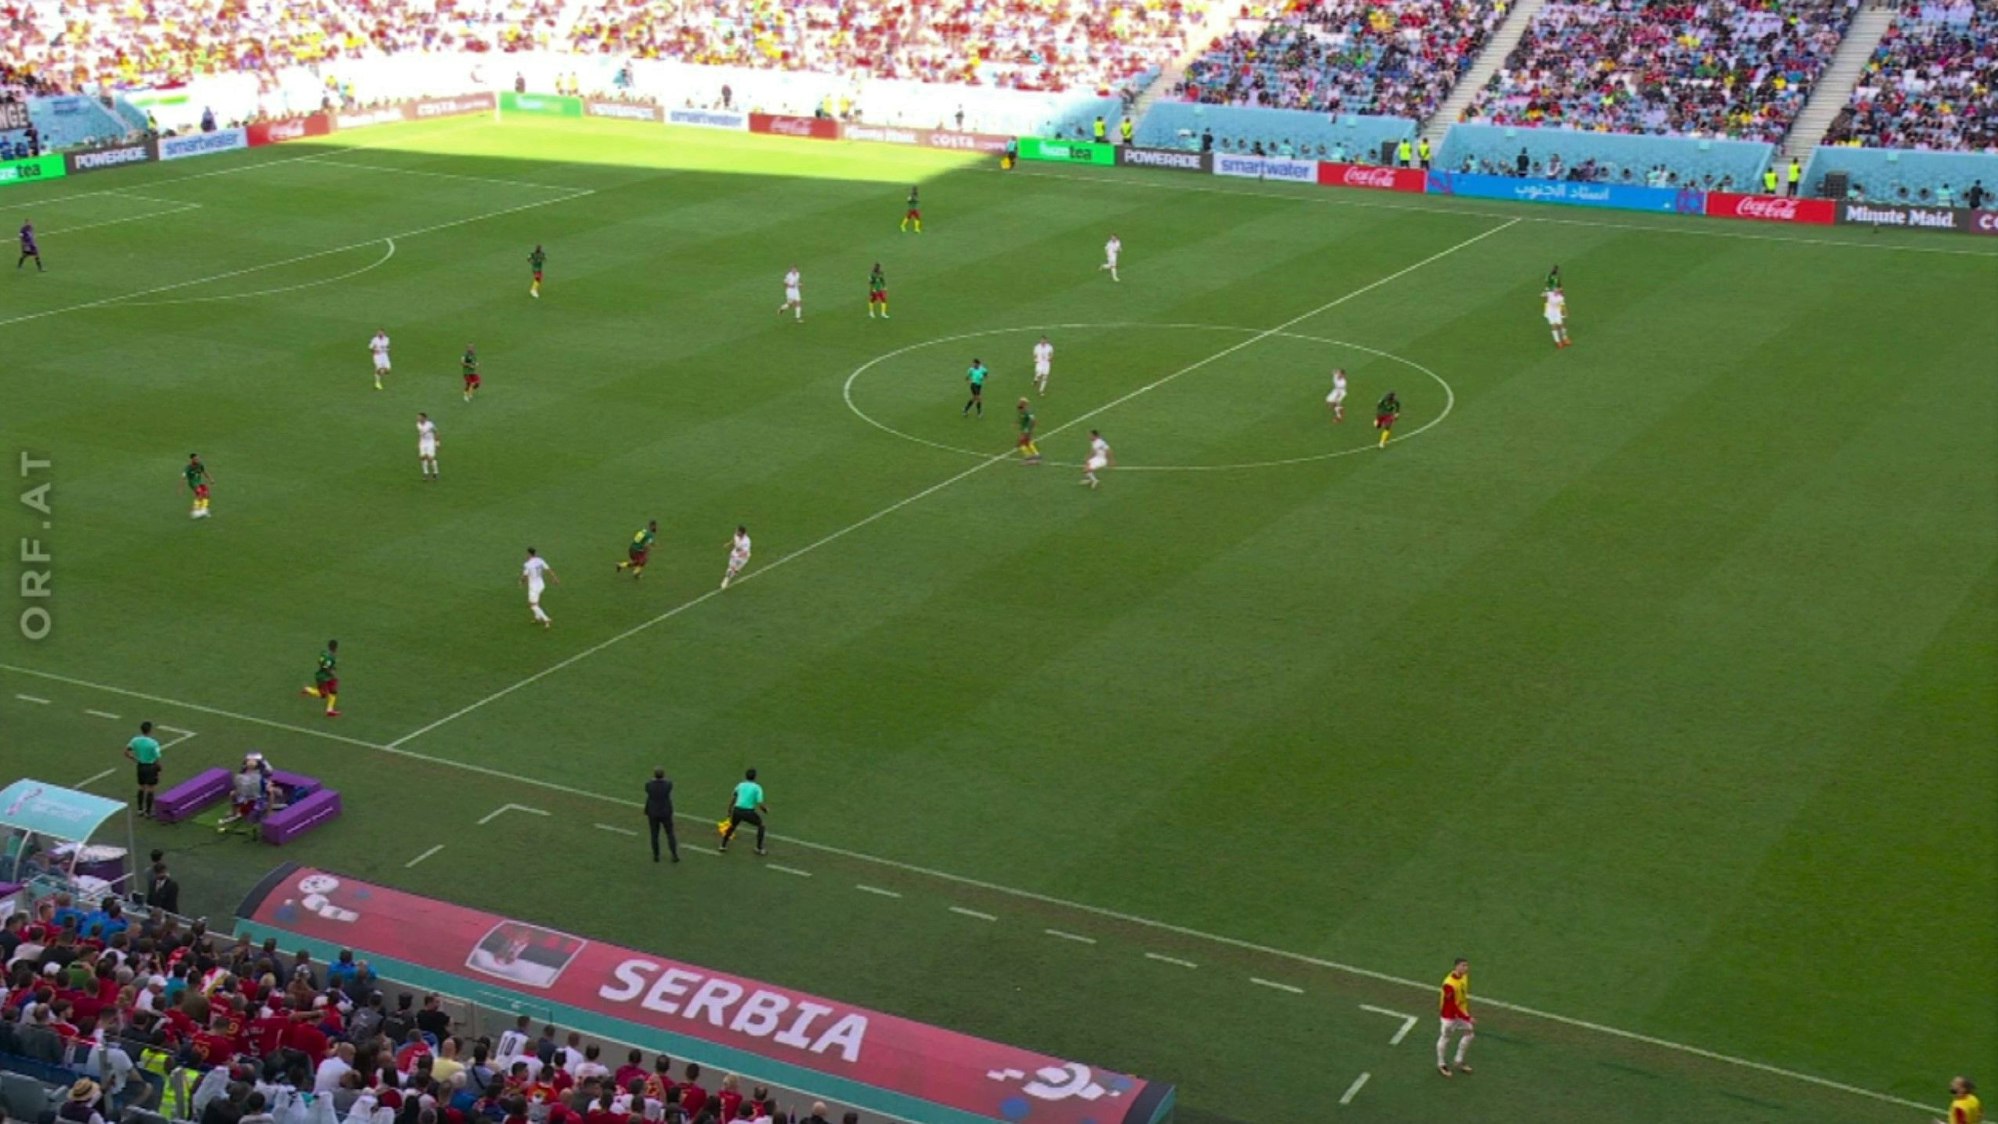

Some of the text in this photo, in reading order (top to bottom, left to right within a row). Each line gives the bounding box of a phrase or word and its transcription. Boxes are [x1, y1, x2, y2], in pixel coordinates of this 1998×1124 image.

[931, 133, 975, 148] COSTA
[75, 146, 148, 169] POWERADE
[1124, 149, 1200, 168] POWERADE
[1221, 159, 1309, 178] smartwater
[1846, 205, 1906, 225] Minute
[599, 958, 868, 1063] SERBIA
